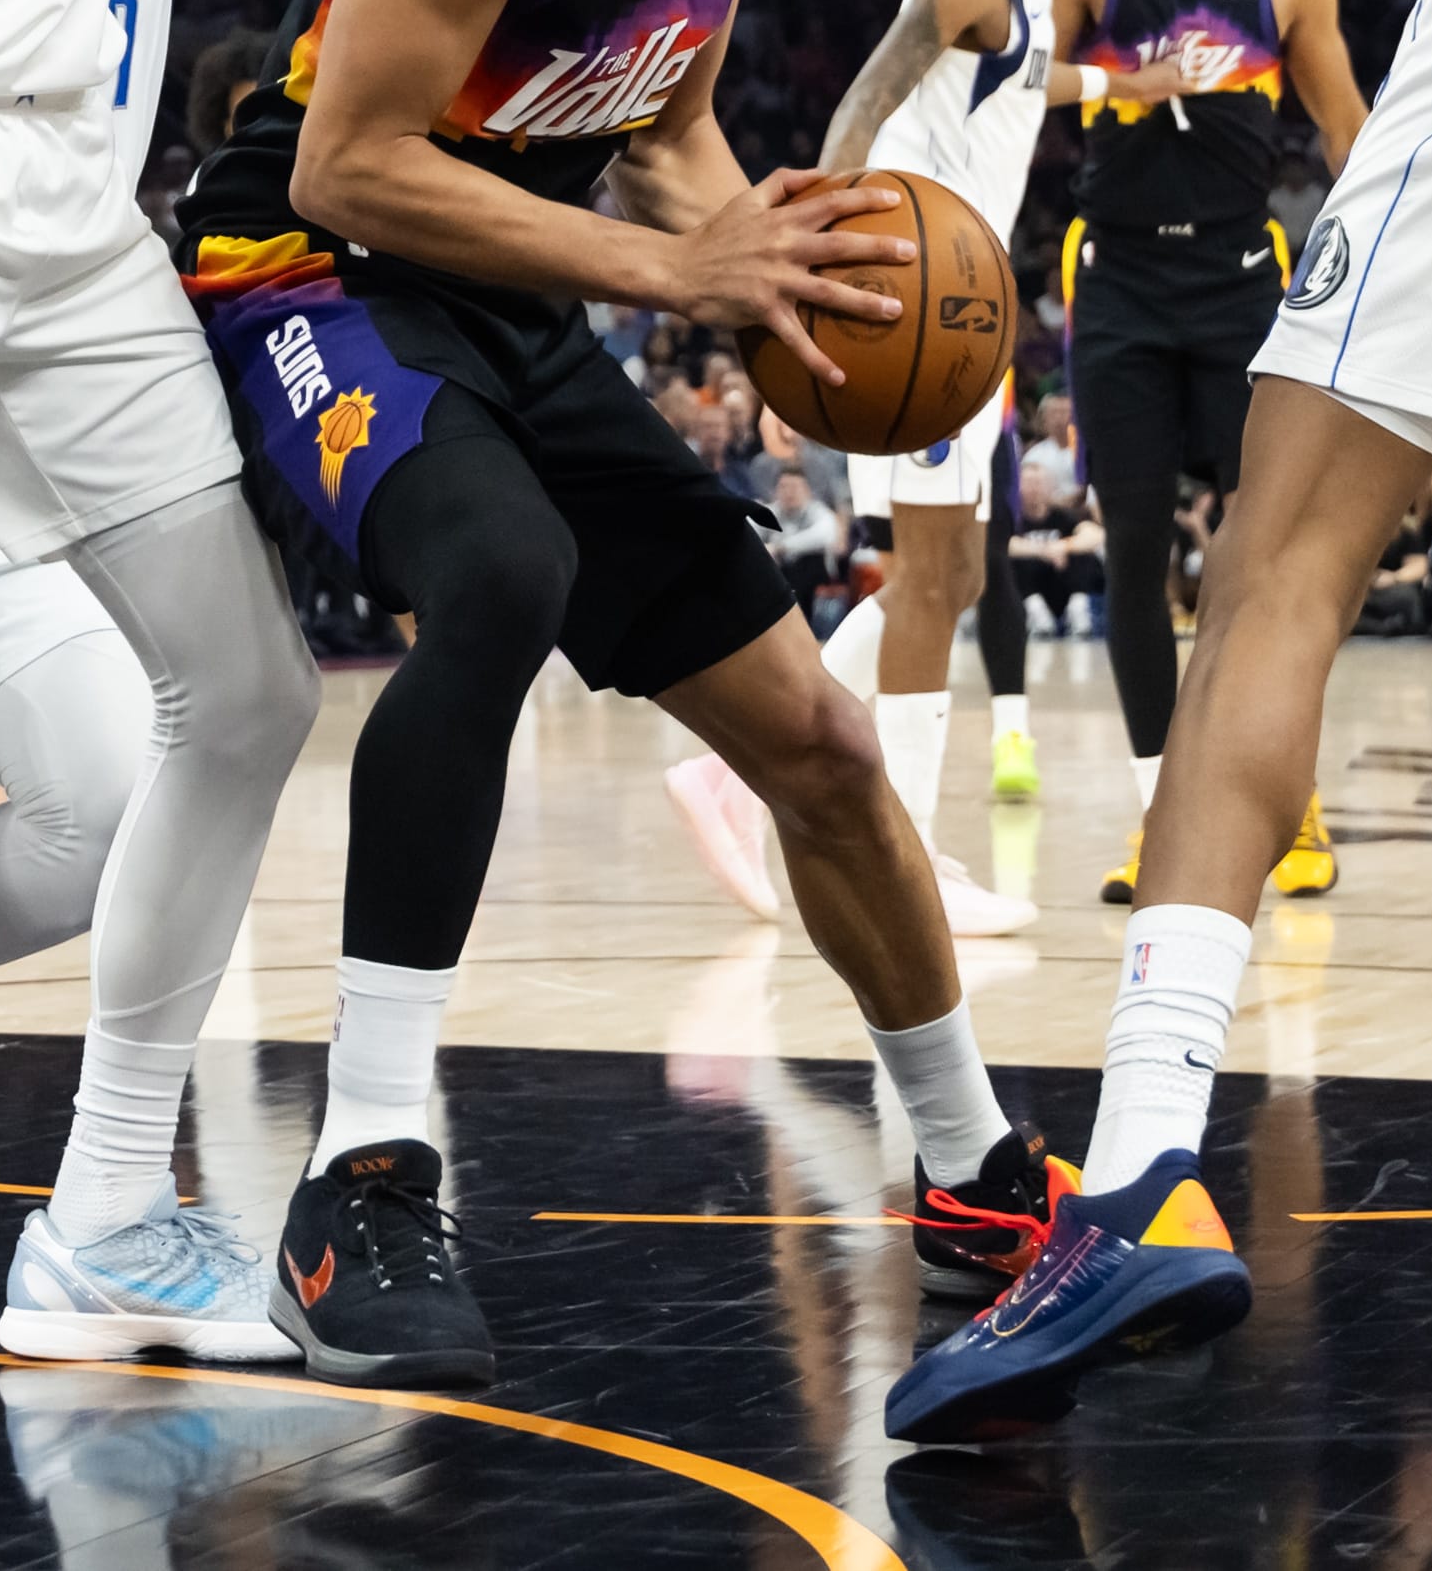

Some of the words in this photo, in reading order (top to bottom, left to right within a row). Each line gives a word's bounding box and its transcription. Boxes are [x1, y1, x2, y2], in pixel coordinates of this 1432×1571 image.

[481, 17, 707, 136] Valle
[596, 45, 638, 78] THE
[265, 314, 333, 420] SUNS
